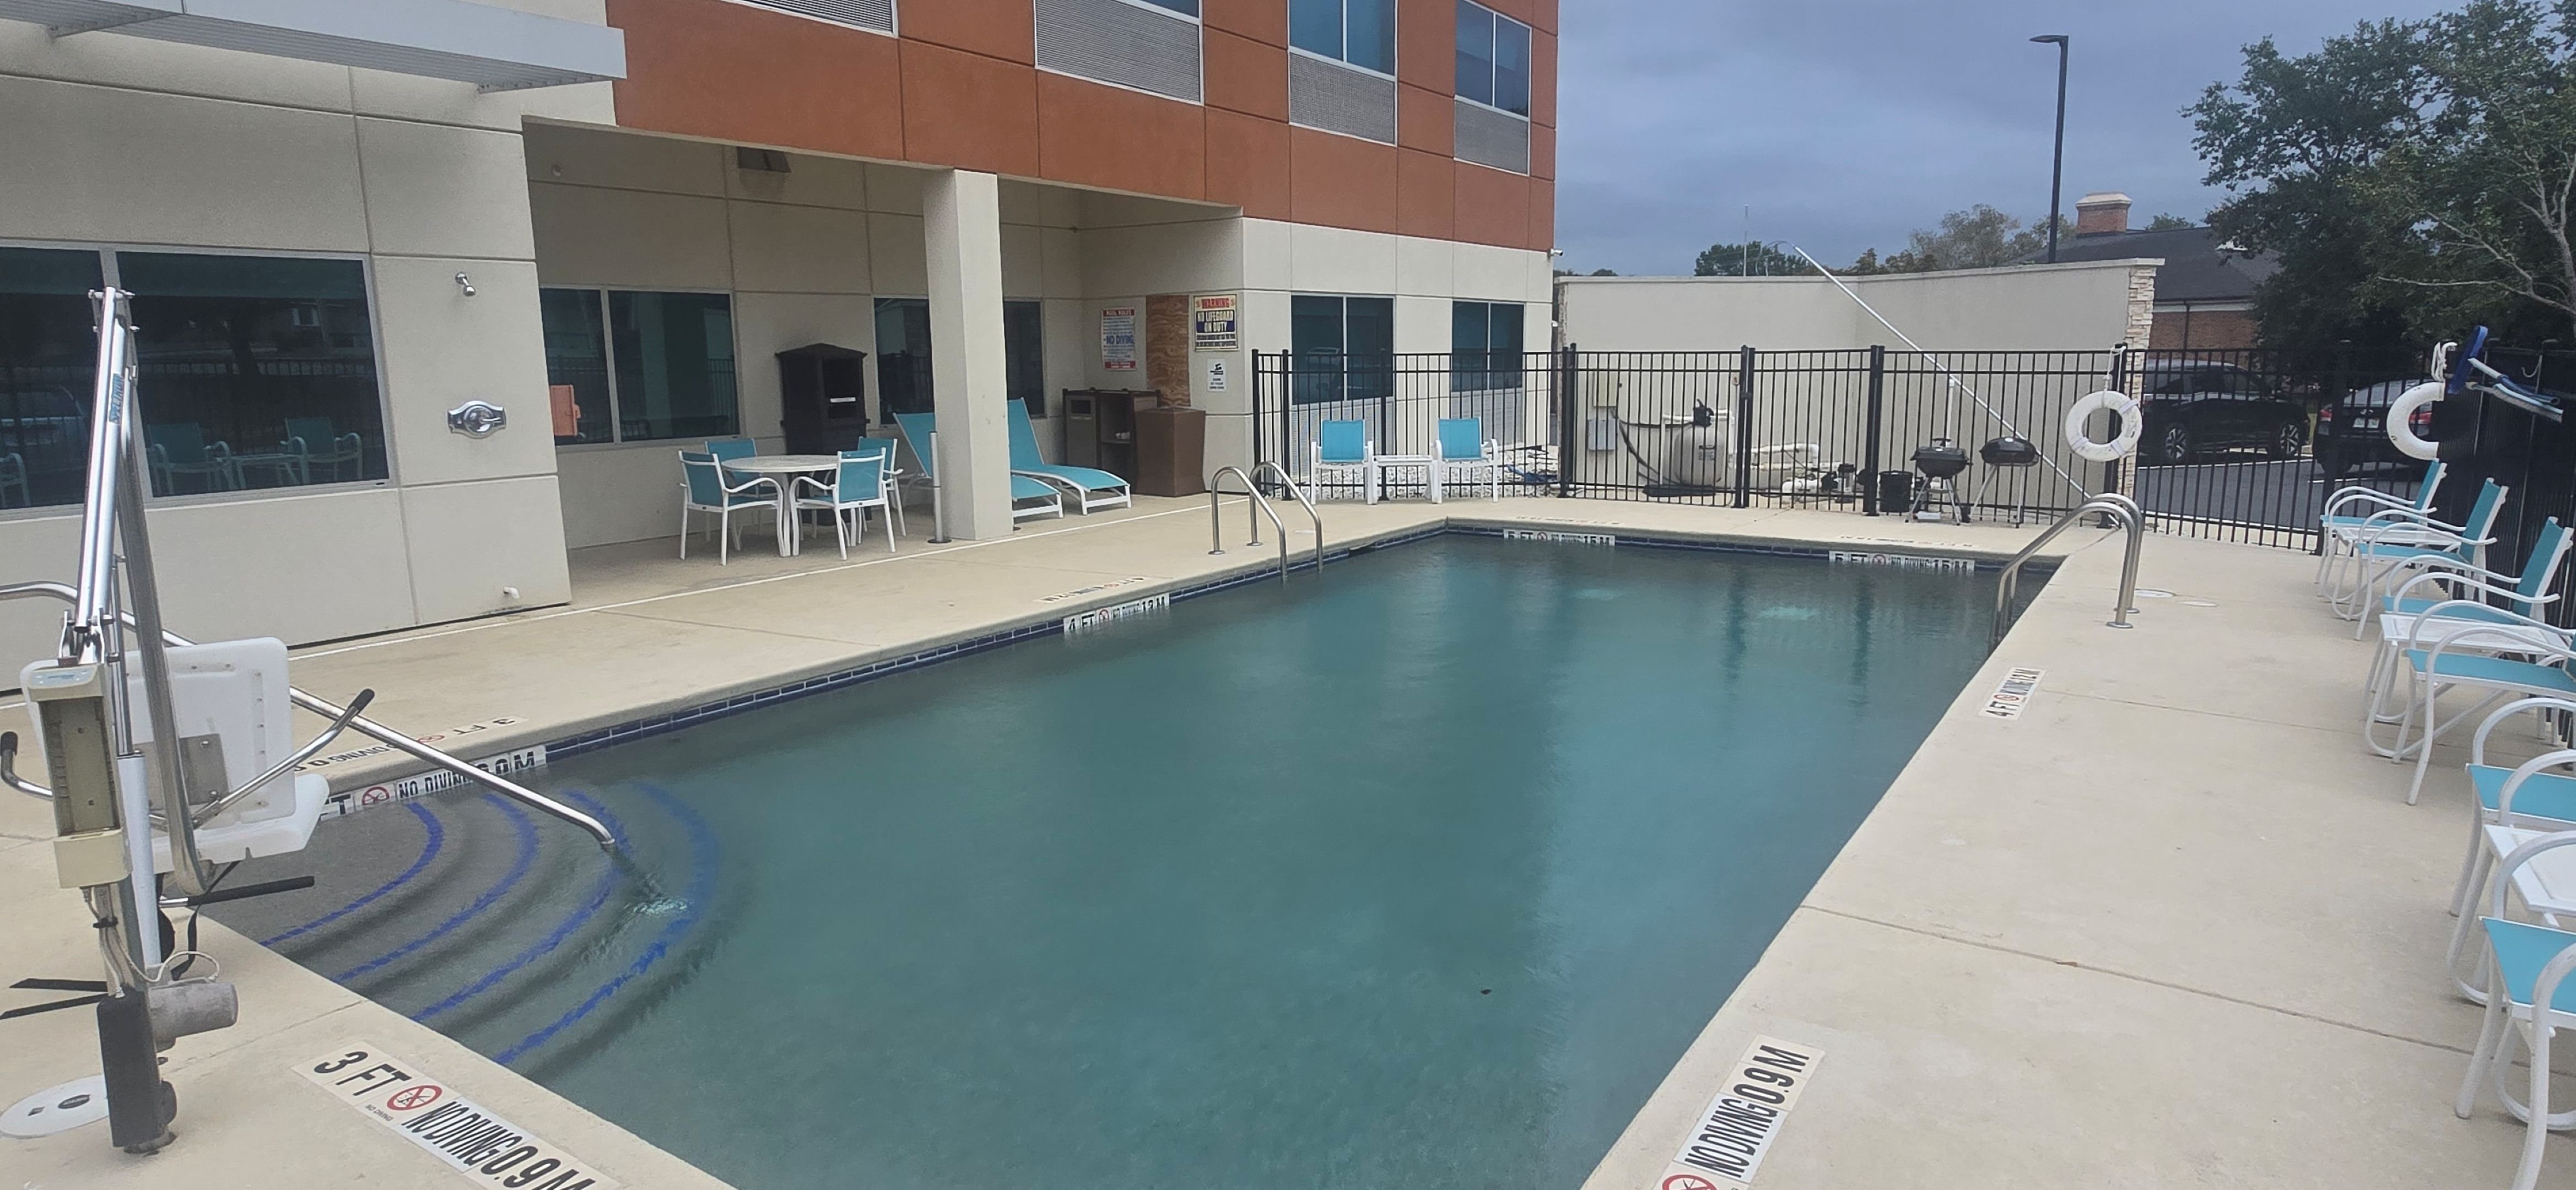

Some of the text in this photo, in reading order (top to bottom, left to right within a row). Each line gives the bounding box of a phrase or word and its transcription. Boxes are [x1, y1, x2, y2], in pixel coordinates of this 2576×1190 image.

[1202, 298, 1229, 309] WARNING
[1198, 311, 1234, 322] NO LIFEGUARD
[1204, 321, 1227, 332] ON DUTY
[1106, 334, 1135, 344] NO DIVING
[1082, 614, 1094, 627] FT
[1989, 701, 2020, 711] FT
[453, 724, 487, 735] FT
[328, 747, 390, 762] DIVING
[399, 781, 418, 798] NO
[514, 751, 534, 770] M
[314, 1051, 412, 1096] 3 FT
[373, 1108, 393, 1122] DIVING
[401, 1101, 469, 1133] NO
[1684, 1045, 1810, 1178] NO DIVING 0.9 M
[423, 1113, 522, 1166] DIVING
[480, 1145, 561, 1188] 0.9
